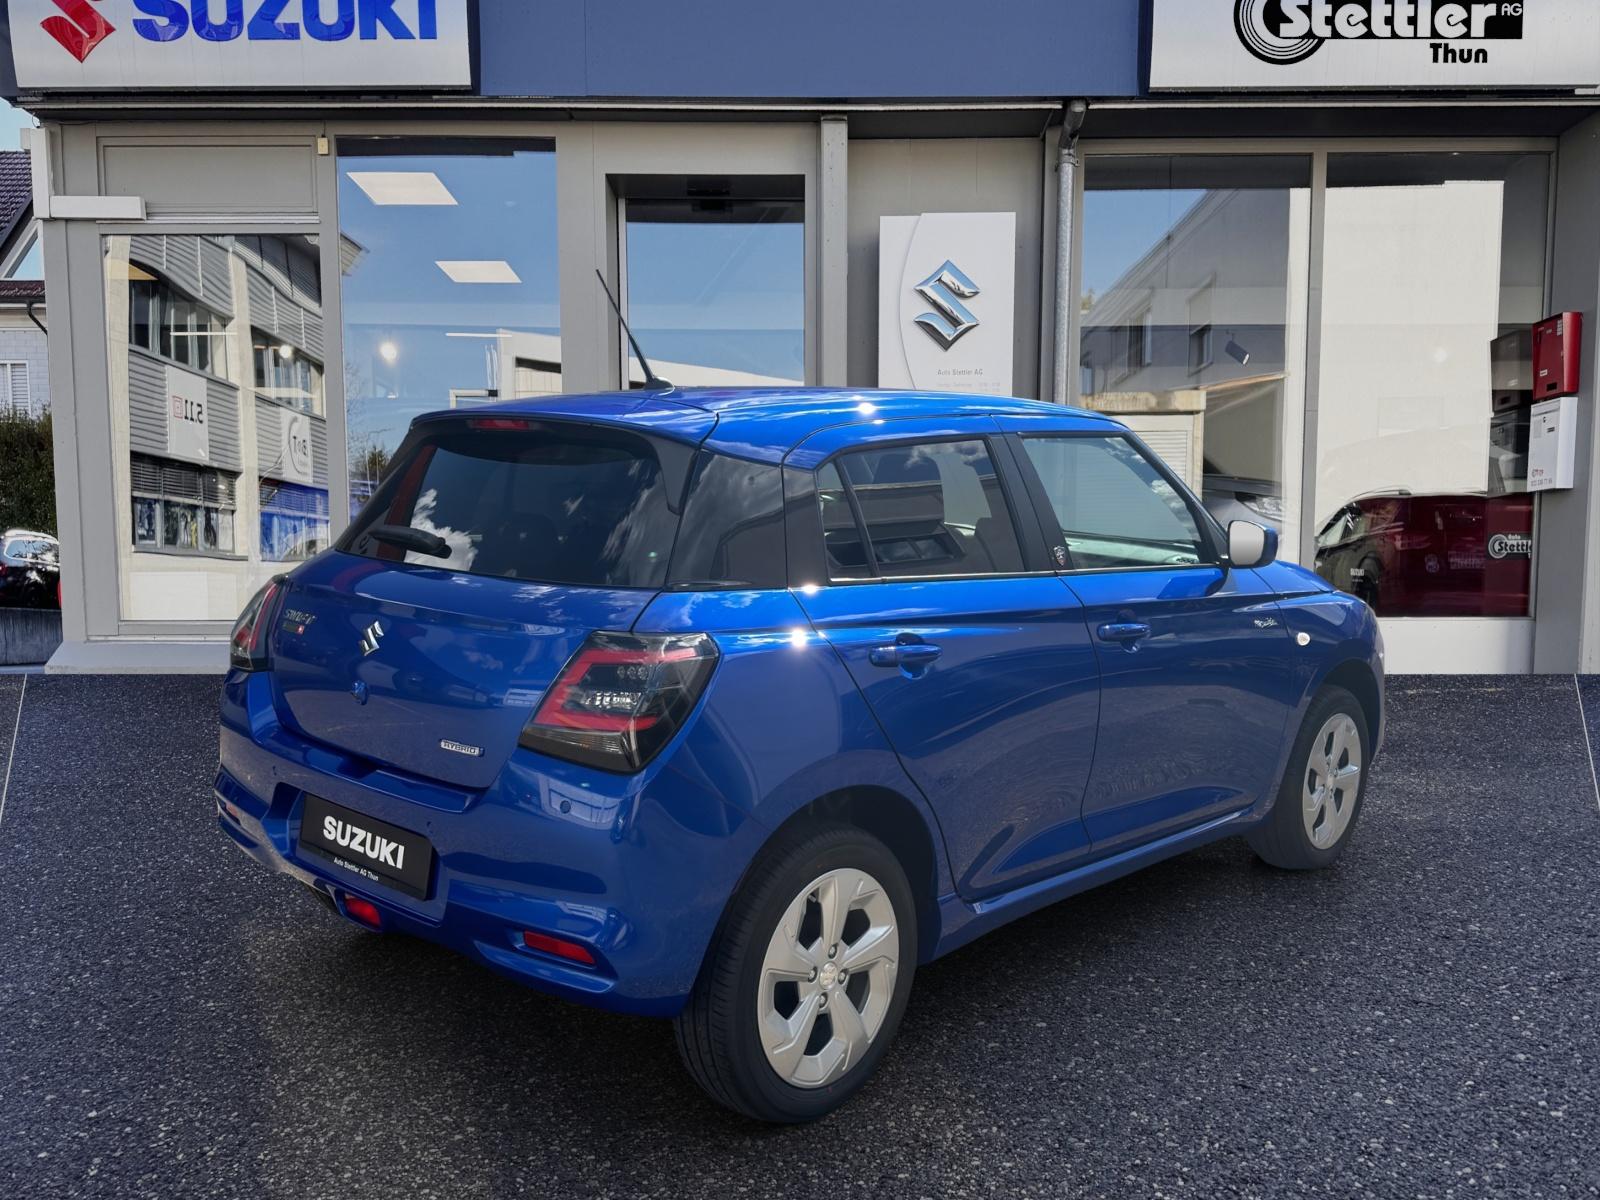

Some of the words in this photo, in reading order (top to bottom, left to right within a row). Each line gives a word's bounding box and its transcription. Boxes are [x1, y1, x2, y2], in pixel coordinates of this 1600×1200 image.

[132, 0, 437, 42] SUZUKI
[1278, 0, 1497, 39] Stettler
[1501, 3, 1523, 17] AG
[1430, 42, 1489, 63] Thun
[442, 740, 477, 755] HYBRID
[323, 815, 405, 870] SUZUKI
[333, 856, 344, 867] Auto
[359, 868, 367, 877] AG
[367, 871, 379, 882] Thun
